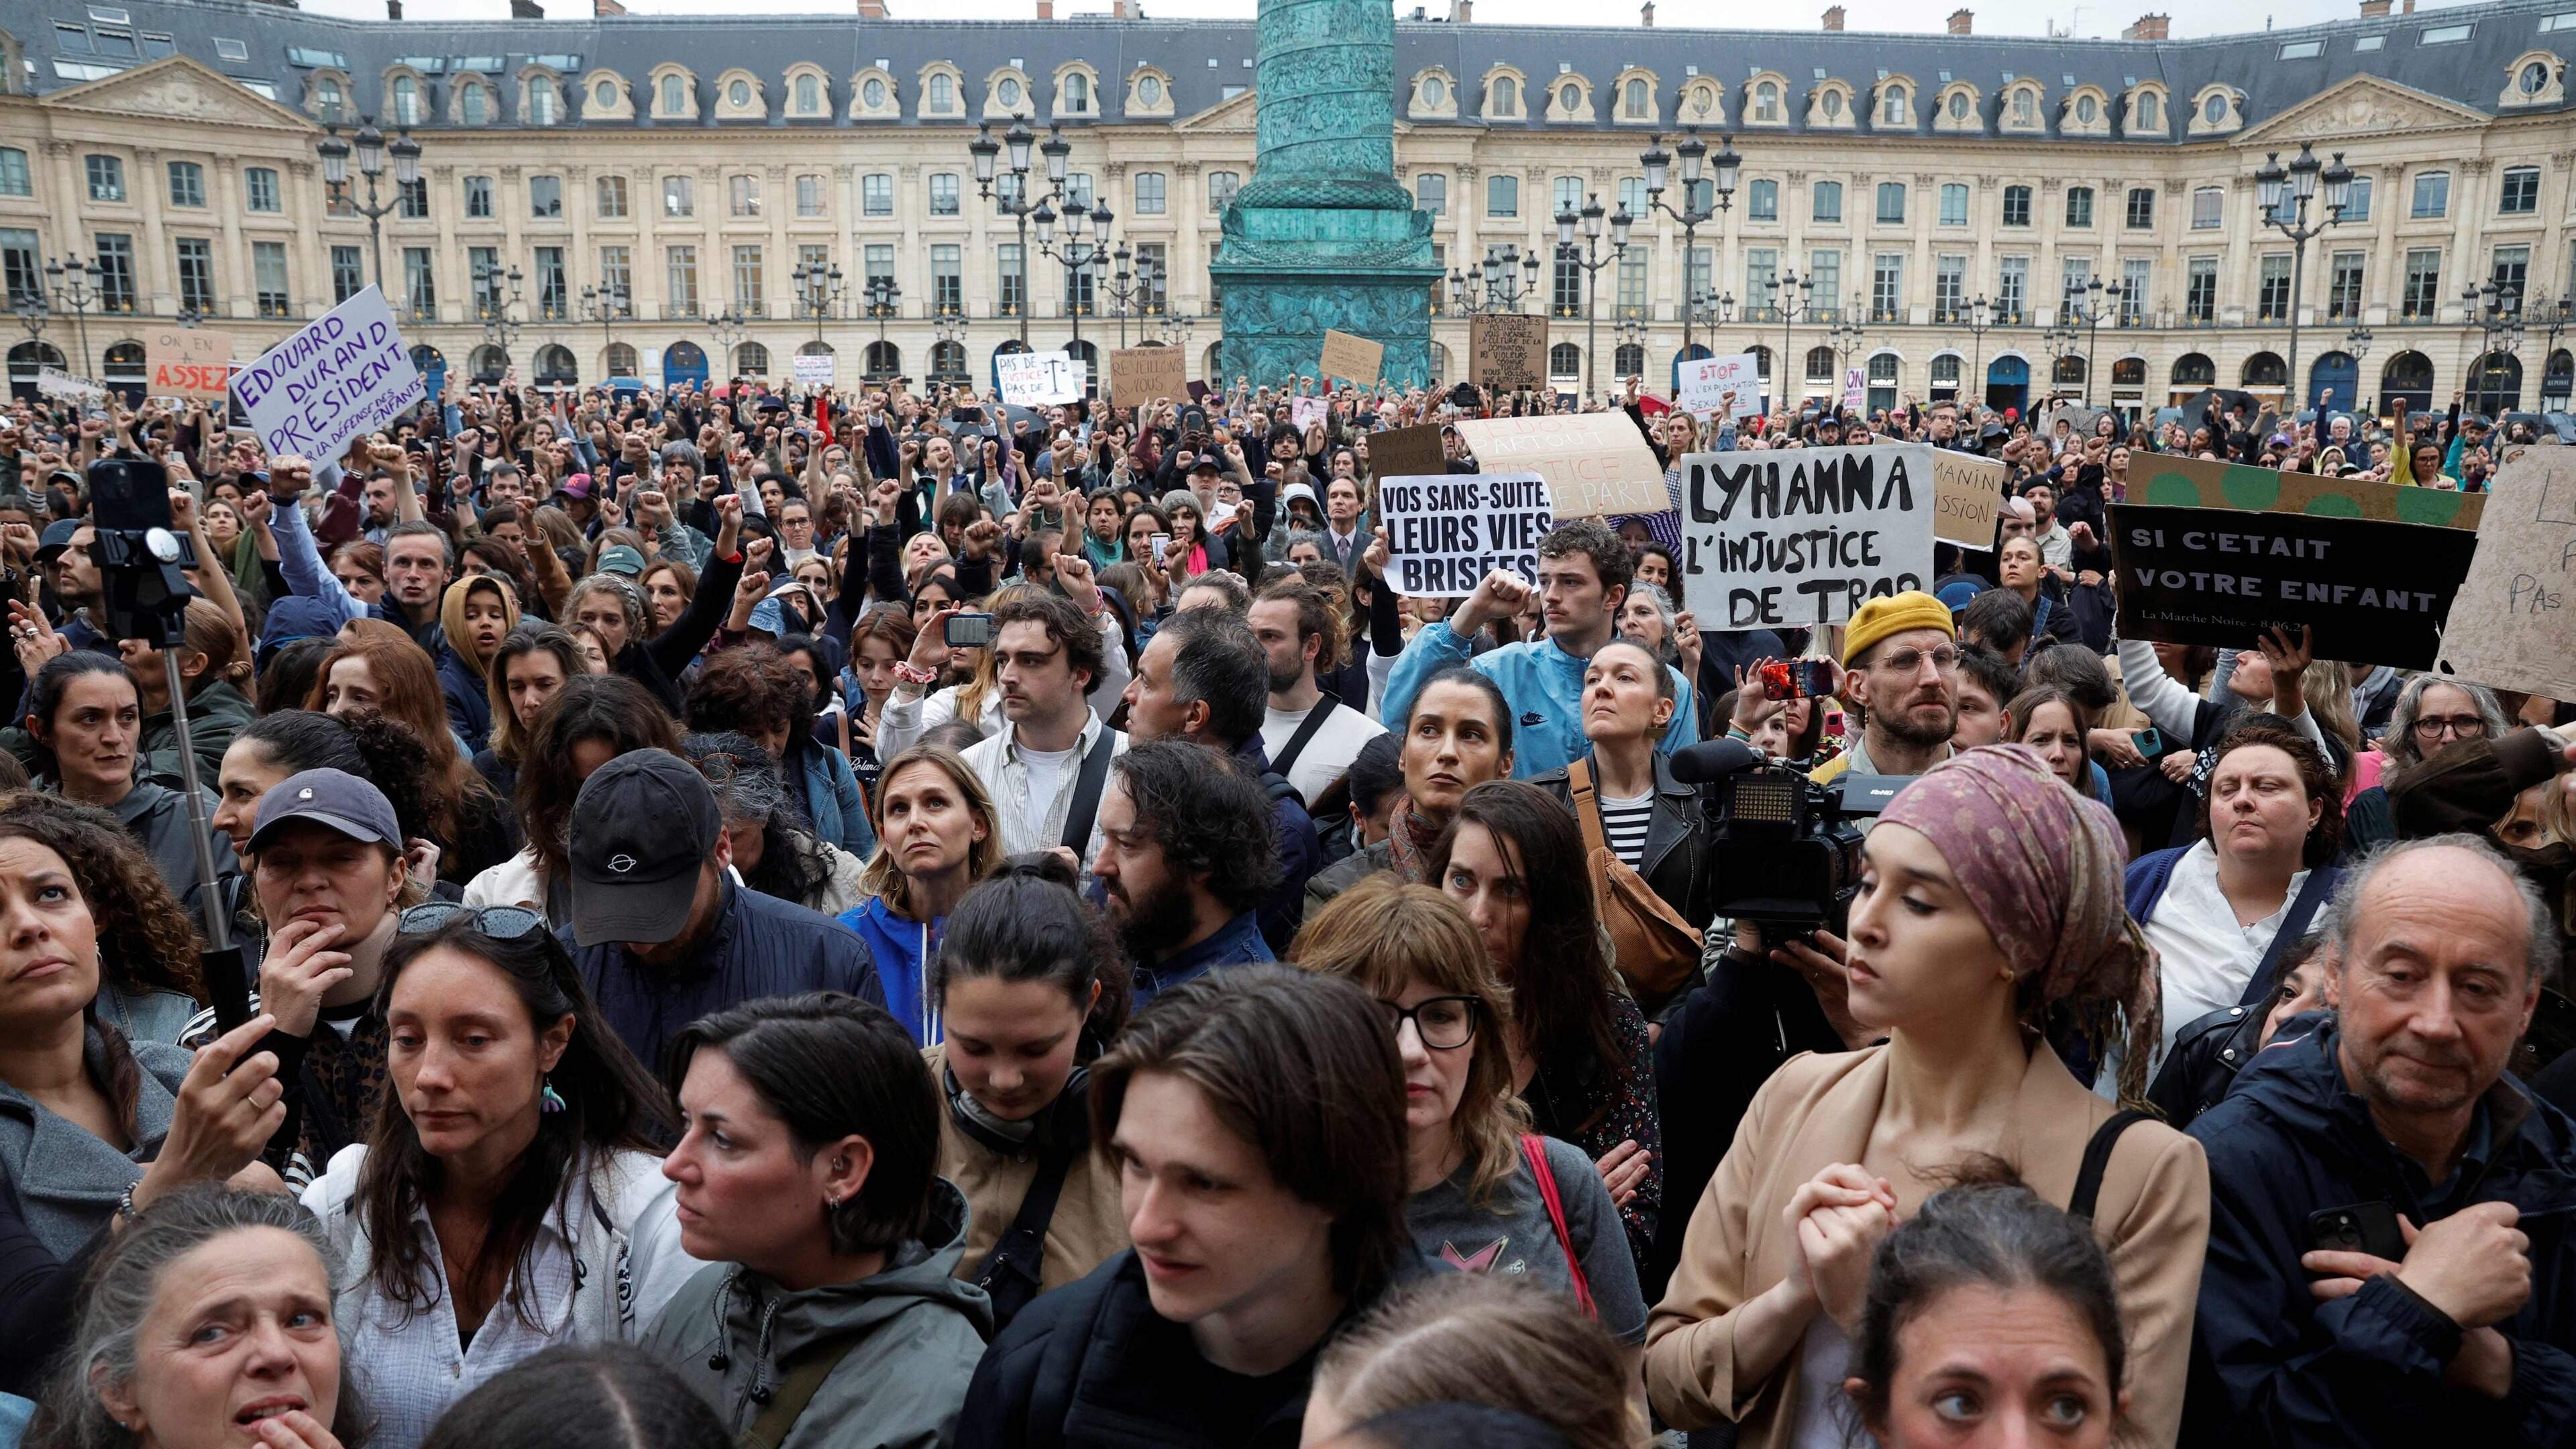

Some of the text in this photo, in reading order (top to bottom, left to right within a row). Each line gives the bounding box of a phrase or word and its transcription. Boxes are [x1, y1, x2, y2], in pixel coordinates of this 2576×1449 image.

[160, 335, 213, 352] ON EN
[156, 364, 227, 391] ASSEZ
[237, 317, 343, 408] EDOUARD
[286, 321, 386, 404] DURAND
[1000, 356, 1036, 371] PAS DE
[1001, 370, 1044, 382] JUSTICE
[1700, 363, 1740, 380] STOP
[1005, 383, 1043, 394] PAS DE
[1696, 380, 1757, 394] L'EXPLOITATION
[1847, 370, 1864, 388] ON
[373, 378, 422, 427] ENFANTS
[1690, 394, 1747, 411] SEXUELE
[316, 441, 332, 461] LA
[331, 405, 373, 443] DÉFENSE
[1470, 431, 1605, 457] PARTOUT
[1383, 481, 1550, 513] VOS SANS-SUITE.
[1582, 480, 1654, 511] PART
[1690, 453, 1914, 524] LYHANNA
[1387, 512, 1551, 554] LEURS VIES
[2132, 529, 2331, 560] SI C'ETAIT
[2135, 568, 2436, 612] VOTRE ENFANT
[2510, 574, 2561, 614] PAS
[1729, 586, 1784, 628] DE
[2141, 609, 2157, 619] La
[2161, 611, 2207, 624] Marche
[2211, 615, 2248, 627] Noire
[2260, 619, 2302, 633] 8.06.2
